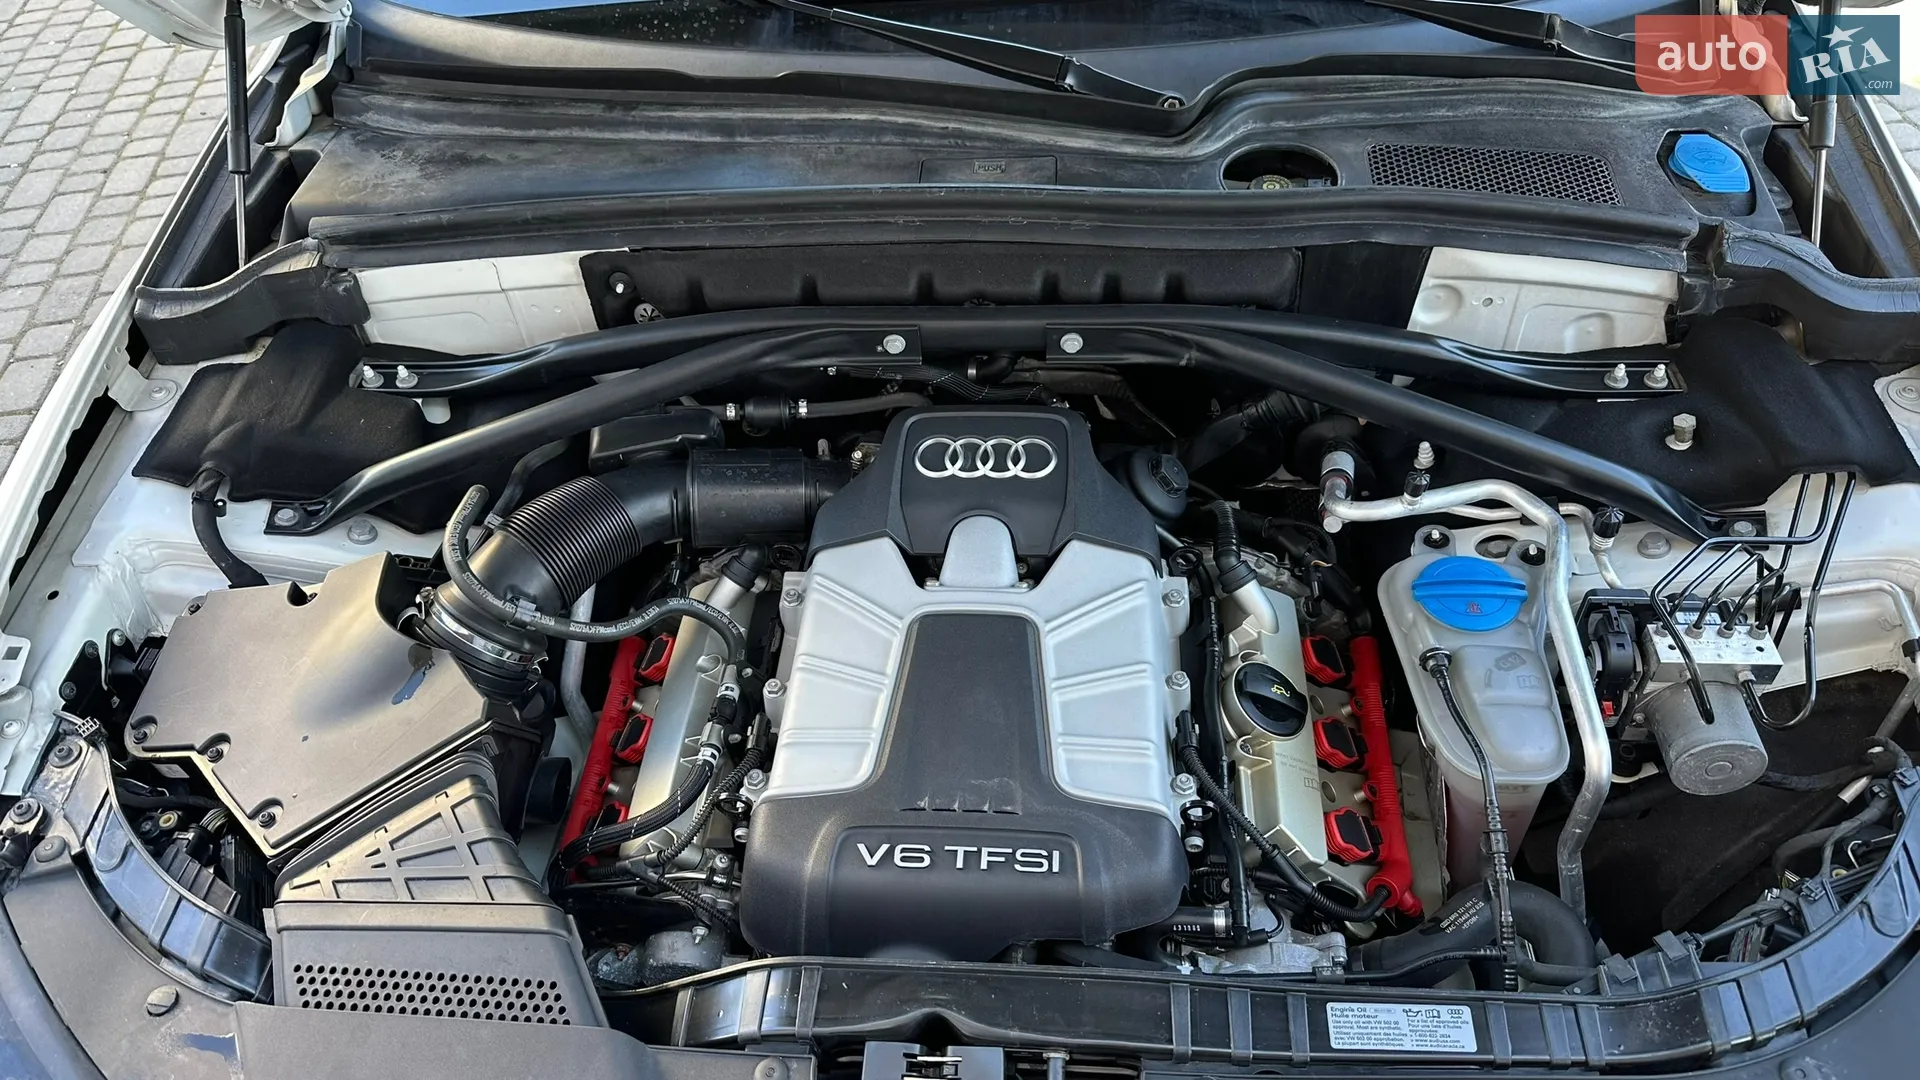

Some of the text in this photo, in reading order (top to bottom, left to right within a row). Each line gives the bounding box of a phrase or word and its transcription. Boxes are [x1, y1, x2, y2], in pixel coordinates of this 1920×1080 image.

[977, 163, 1002, 172] PUSH
[856, 843, 1060, 873] V6 TFSI
